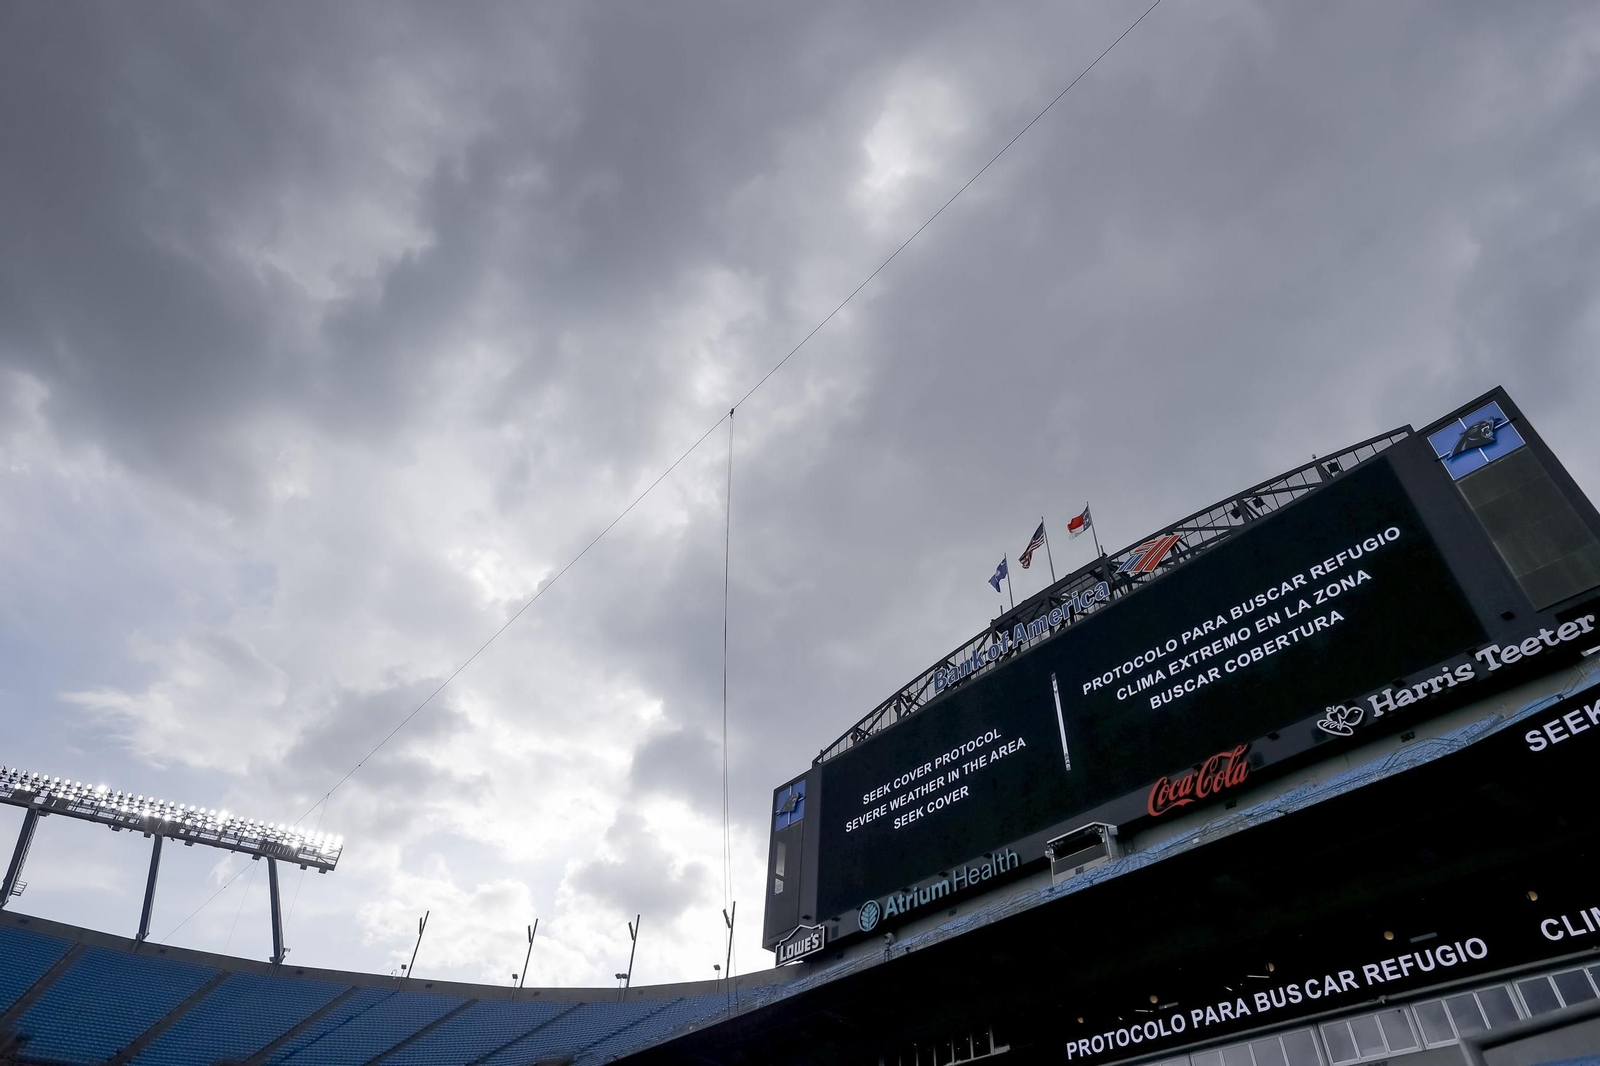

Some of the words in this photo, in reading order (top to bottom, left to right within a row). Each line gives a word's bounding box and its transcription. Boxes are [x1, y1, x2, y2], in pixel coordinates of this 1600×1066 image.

[933, 649, 987, 693] Bank
[987, 630, 1011, 661] of
[1012, 580, 1111, 649] America
[1082, 638, 1178, 695] PROTOCOLO
[1181, 614, 1228, 645] PARA
[1231, 574, 1307, 620] BUSCAR
[1309, 526, 1400, 578] REFUGIO
[1116, 670, 1166, 701] CLIMA
[1169, 627, 1251, 674] EXTREMO
[1255, 611, 1282, 633] EN
[1285, 600, 1312, 620] LA
[1313, 569, 1372, 605] ZONA
[1149, 667, 1222, 710] BUSCAR
[1224, 610, 1345, 673] COBERTURA
[1367, 662, 1475, 718] Harris
[1475, 614, 1595, 671] Teeter
[845, 806, 887, 833] SEVERE
[890, 776, 945, 811] WEATHER
[948, 768, 960, 784] IN
[962, 756, 987, 776] THE
[990, 737, 1026, 763] AREA
[863, 782, 891, 805] SEEK
[893, 762, 932, 790] COVER
[934, 728, 1002, 770] PROTOCOL
[893, 809, 924, 830] SEEK
[927, 785, 970, 814] COVER
[779, 932, 820, 962] LOWE'S
[1066, 1013, 1186, 1060] PROTOCOLO
[1191, 997, 1251, 1029] PARA
[1256, 969, 1360, 1013] BUSCAR
[1363, 937, 1489, 986] REFUGIO
